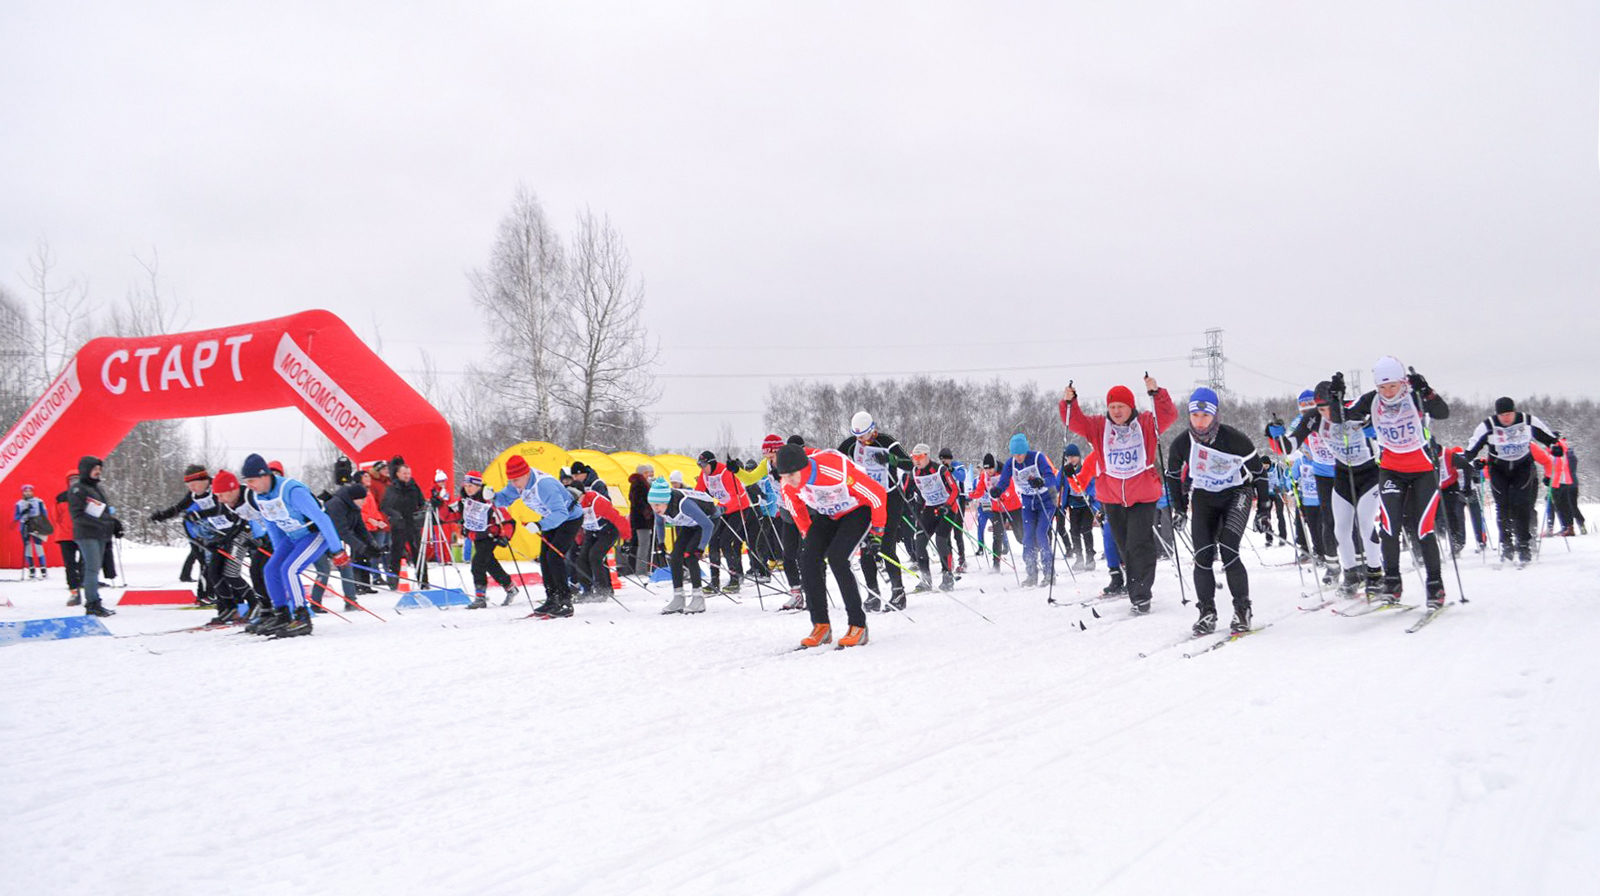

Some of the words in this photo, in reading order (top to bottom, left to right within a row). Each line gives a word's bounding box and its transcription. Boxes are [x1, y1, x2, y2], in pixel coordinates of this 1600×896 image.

[101, 334, 253, 395] СТАРТ
[280, 352, 366, 439] МОСКОМСПОРТ
[1107, 449, 1138, 465] 17394
